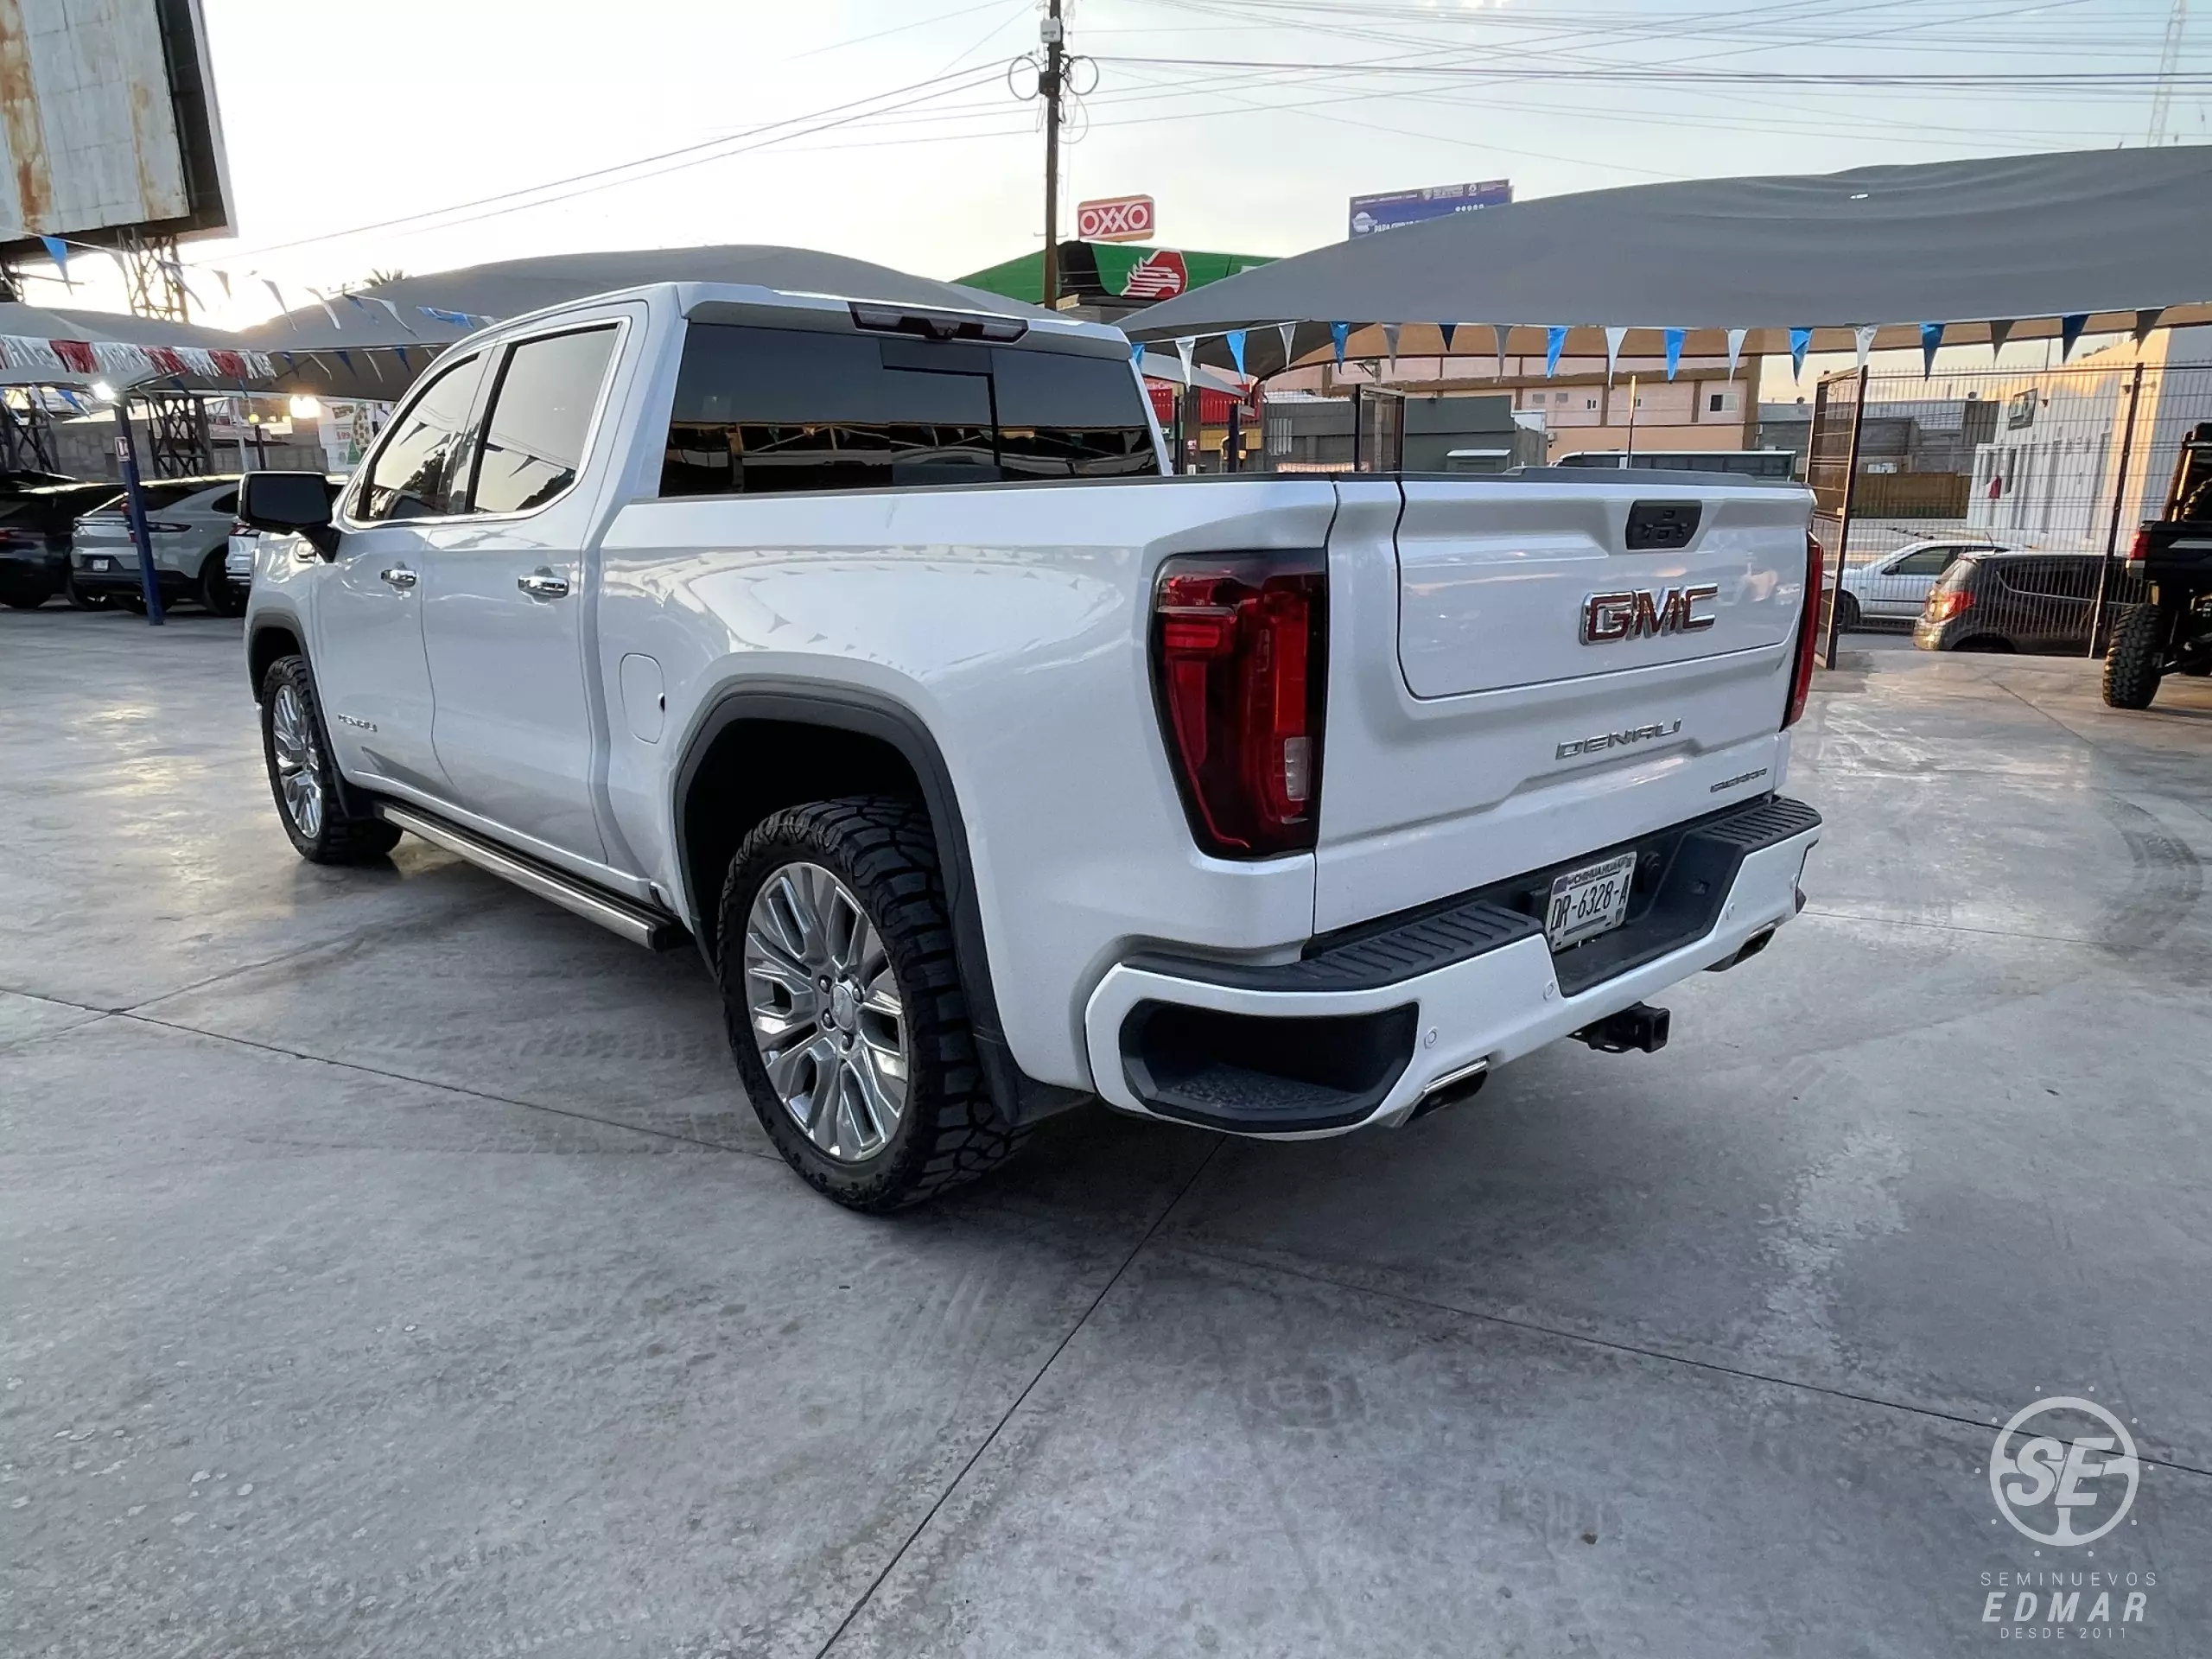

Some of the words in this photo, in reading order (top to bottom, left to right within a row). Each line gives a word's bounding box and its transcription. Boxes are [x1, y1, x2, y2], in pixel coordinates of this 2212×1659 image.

[1080, 204, 1148, 236] OXXO
[1580, 583, 1718, 646] GMC
[1555, 718, 1681, 760] DENALI
